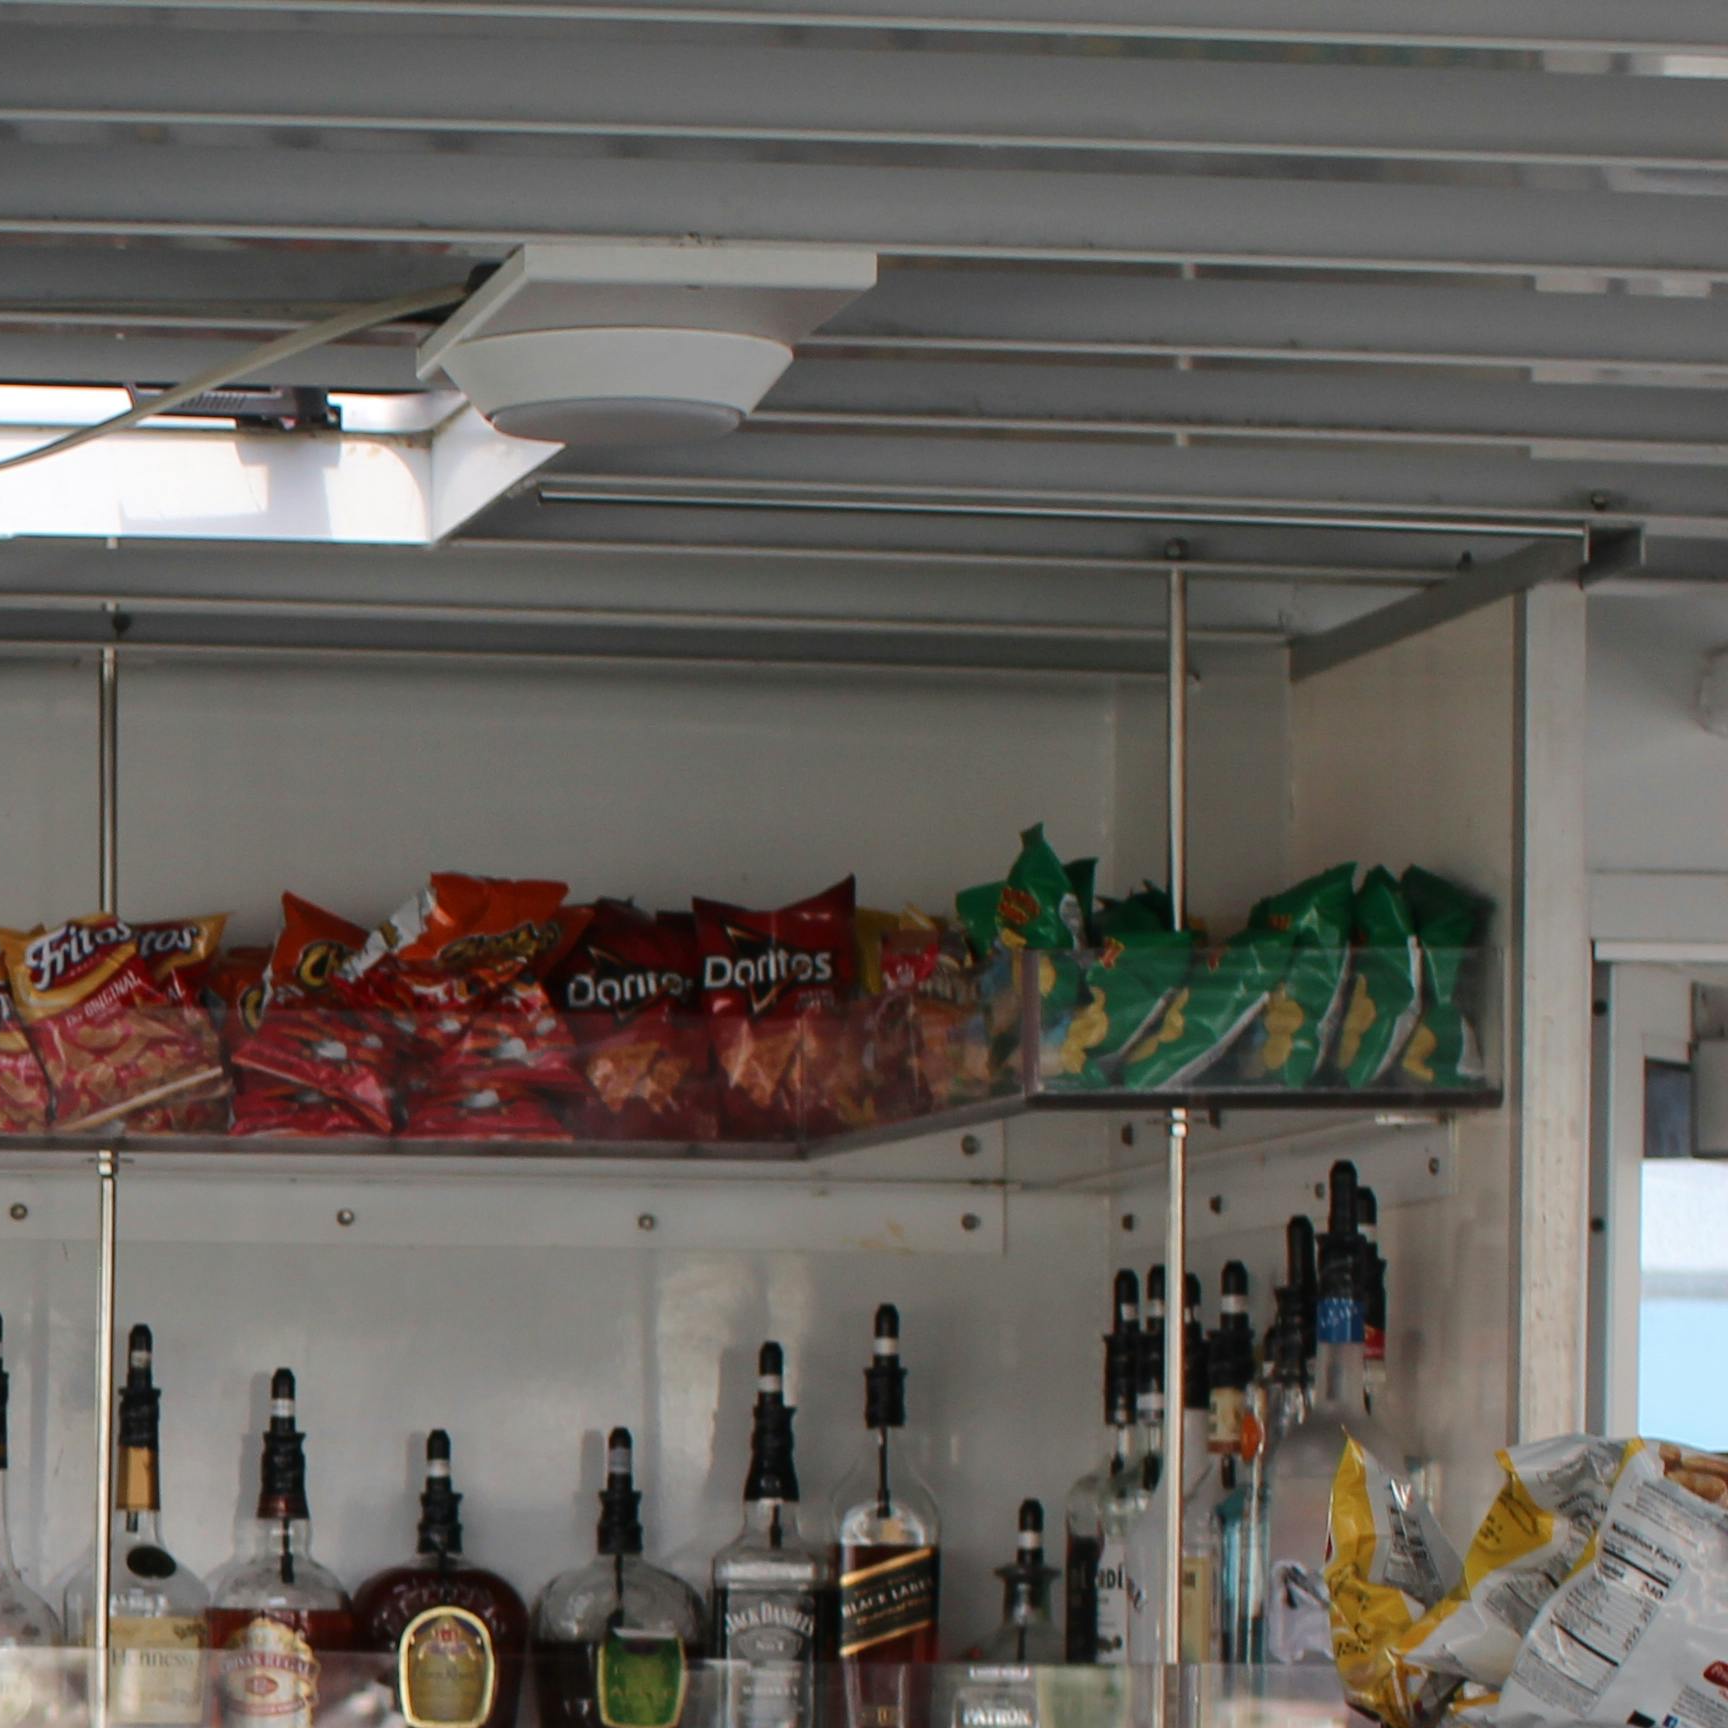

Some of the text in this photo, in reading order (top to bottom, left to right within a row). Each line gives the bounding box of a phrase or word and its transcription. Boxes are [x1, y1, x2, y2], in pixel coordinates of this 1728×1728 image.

[25, 920, 132, 991] Fritos
[704, 951, 833, 989] Doritos
[842, 1595, 886, 1618] BLACK
